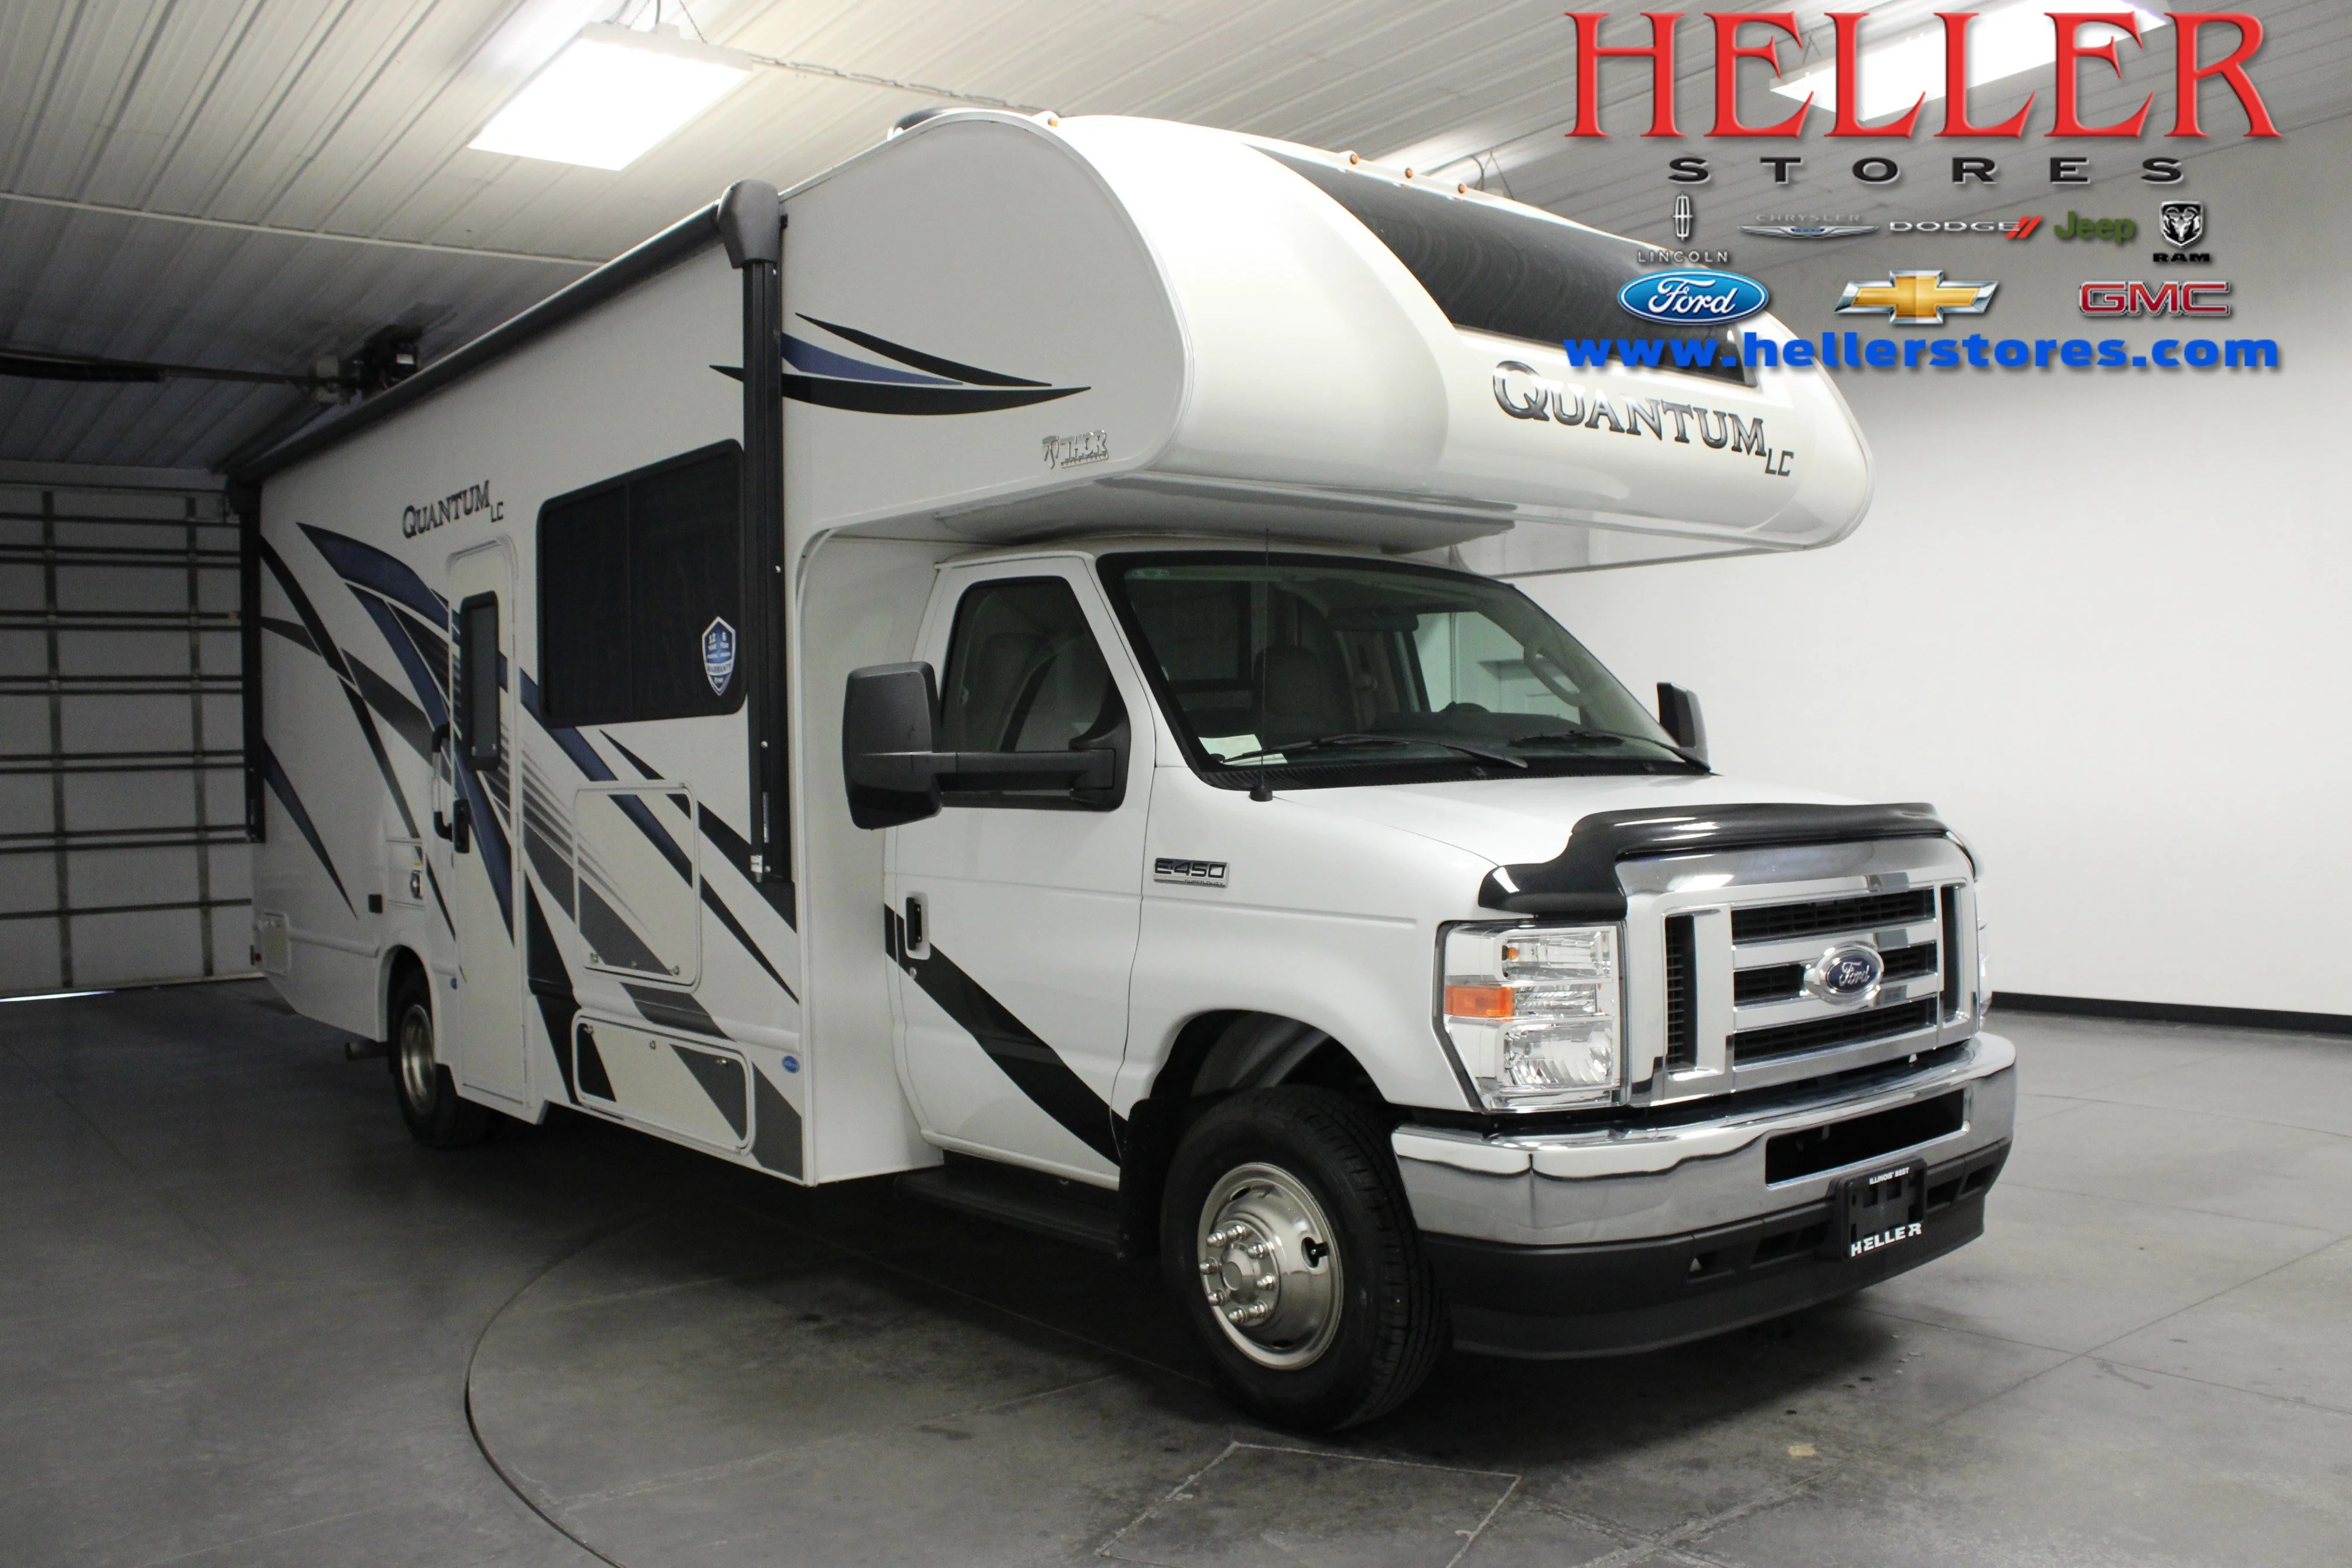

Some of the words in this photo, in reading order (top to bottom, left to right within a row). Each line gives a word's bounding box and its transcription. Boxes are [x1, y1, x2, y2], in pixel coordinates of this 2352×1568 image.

[1492, 360, 1767, 457] QUANTUM
[1765, 448, 1795, 477] LC
[402, 479, 490, 538] QUANTUM
[491, 501, 504, 522] LC
[1838, 961, 1870, 986] Ford
[1850, 1222, 1923, 1257] HELLER
